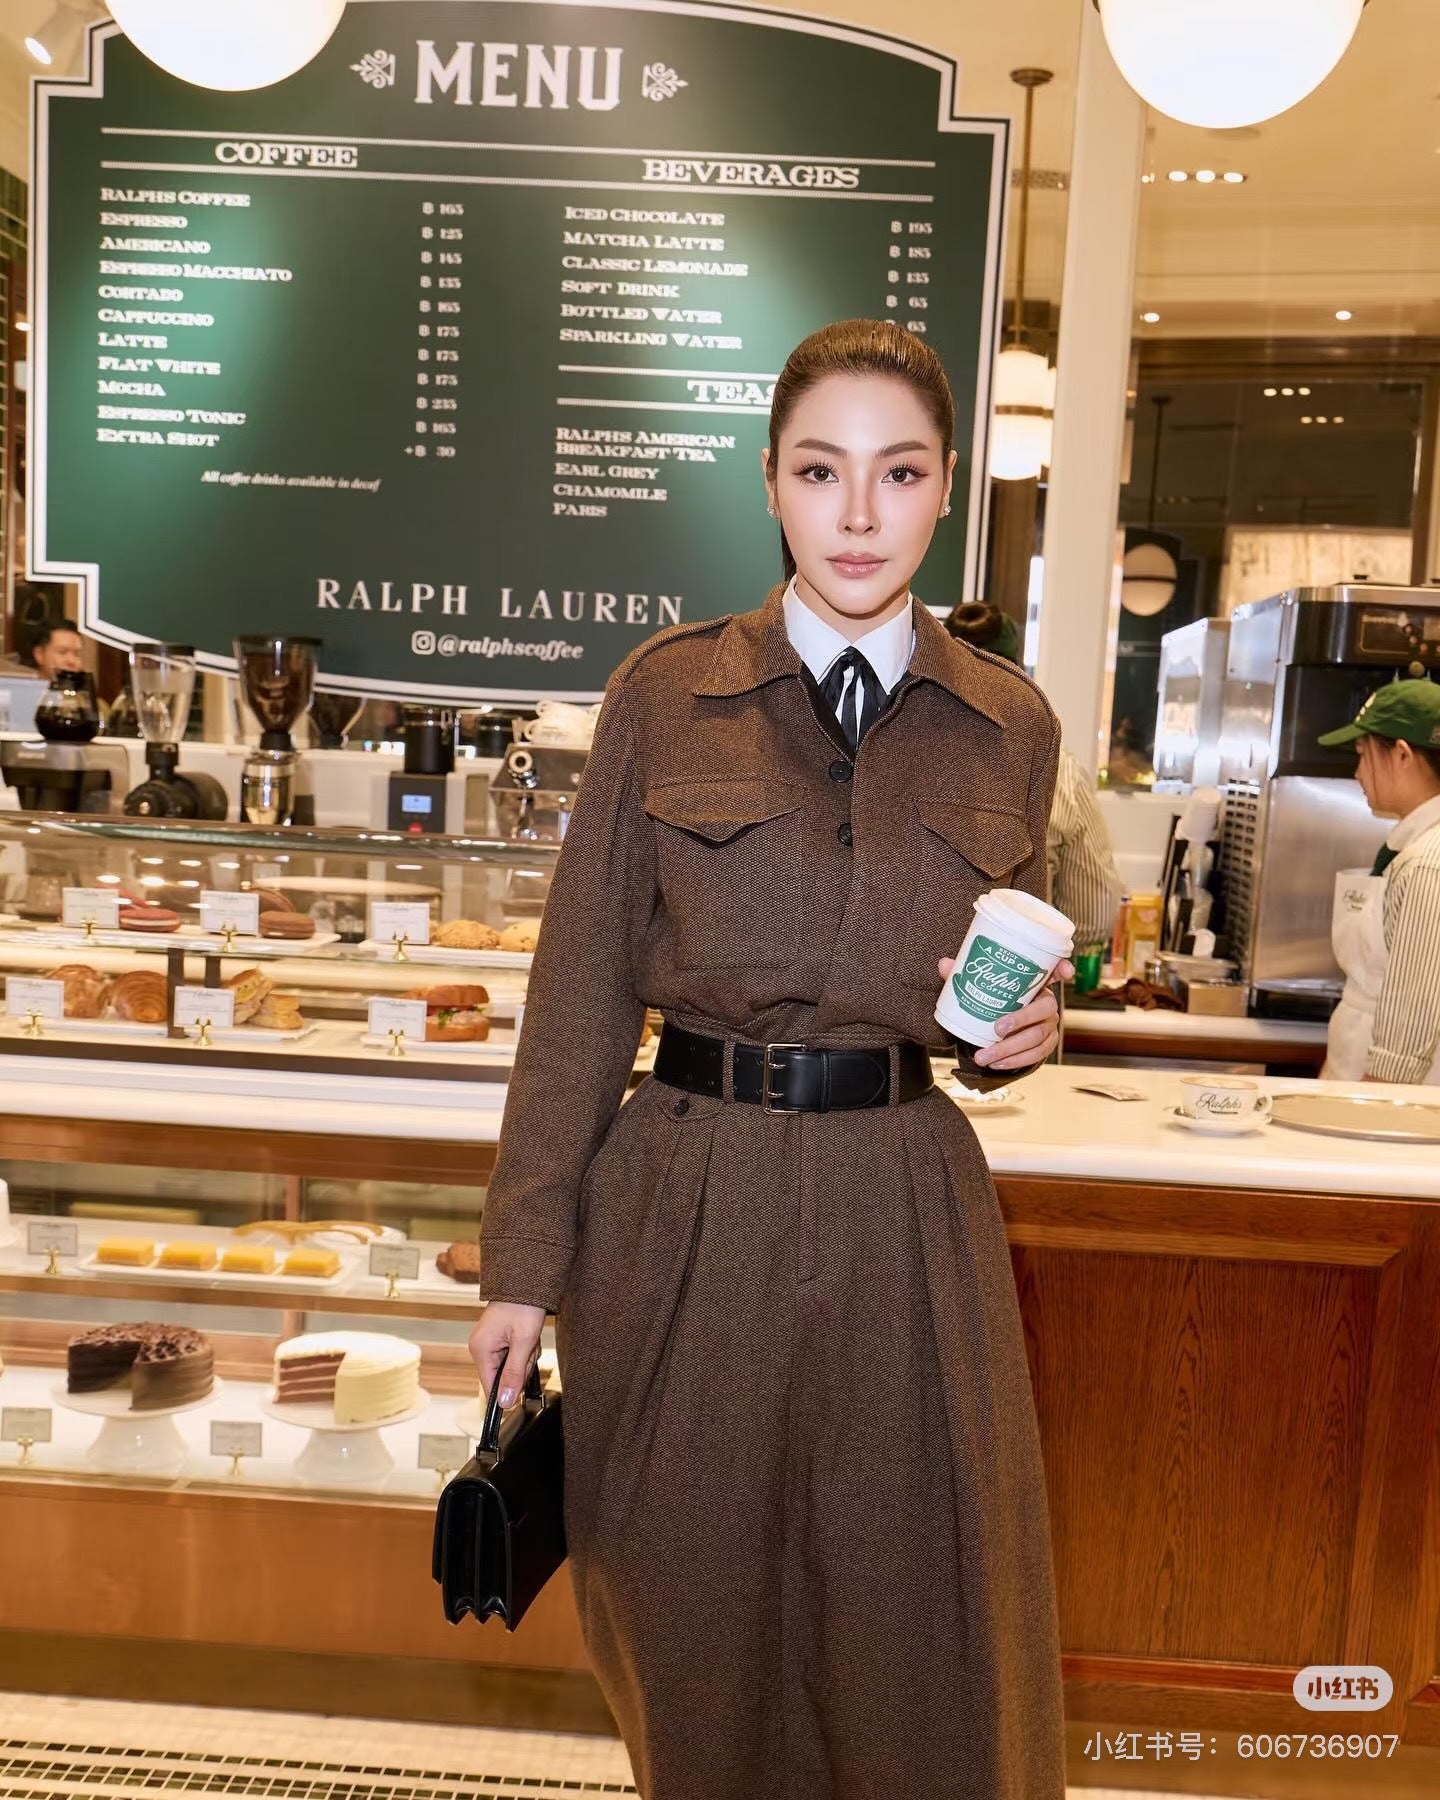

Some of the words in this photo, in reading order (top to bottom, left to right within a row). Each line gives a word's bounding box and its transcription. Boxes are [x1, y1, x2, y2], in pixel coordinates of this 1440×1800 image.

[414, 40, 624, 111] MENU
[214, 141, 359, 168] COFFEE
[641, 157, 860, 188] BEVERAGES
[178, 191, 250, 207] COFFEE
[100, 212, 188, 228] ESPRESSO
[565, 206, 608, 220] ICED
[610, 209, 725, 225] CHOCOLATE
[100, 236, 211, 254] AMERICANO
[563, 231, 649, 247] MATCHA
[655, 235, 724, 251] LATTE
[99, 260, 182, 276] ESPRESSO
[562, 256, 640, 270] CLASSIC
[644, 259, 748, 276] LEMONADE
[561, 280, 612, 294] SOFT
[618, 282, 679, 297] DRINK
[98, 308, 214, 326] CAPPUCCINO
[560, 304, 648, 320] BOTTLED
[652, 308, 722, 323] WATER
[98, 332, 167, 348] LATTE
[560, 328, 667, 345] SPARKLING
[672, 333, 742, 349] WATER
[98, 356, 153, 371] FLAT
[155, 359, 221, 375] WHITE
[97, 380, 166, 396] MOCHA
[97, 405, 185, 422] ESPRESSO
[186, 409, 246, 425] TONIC
[96, 428, 165, 444] EXTRA
[167, 432, 220, 447] SHOT
[556, 427, 632, 443] RALPHS
[634, 431, 736, 449] AMERICAN
[556, 442, 671, 460] BREAKFAST
[673, 447, 717, 463] TEA
[554, 462, 605, 476] EARL
[608, 466, 659, 479] GREY
[553, 483, 667, 501] CHAMOMILE
[553, 502, 607, 517] PARIS
[316, 579, 468, 616] RALPH
[500, 587, 683, 625] LAUREN
[437, 635, 584, 661] @ralphscoffee
[984, 946, 993, 955] A
[994, 951, 1016, 965] CUP
[1016, 962, 1031, 973] OF
[980, 982, 1014, 999] COFFEE
